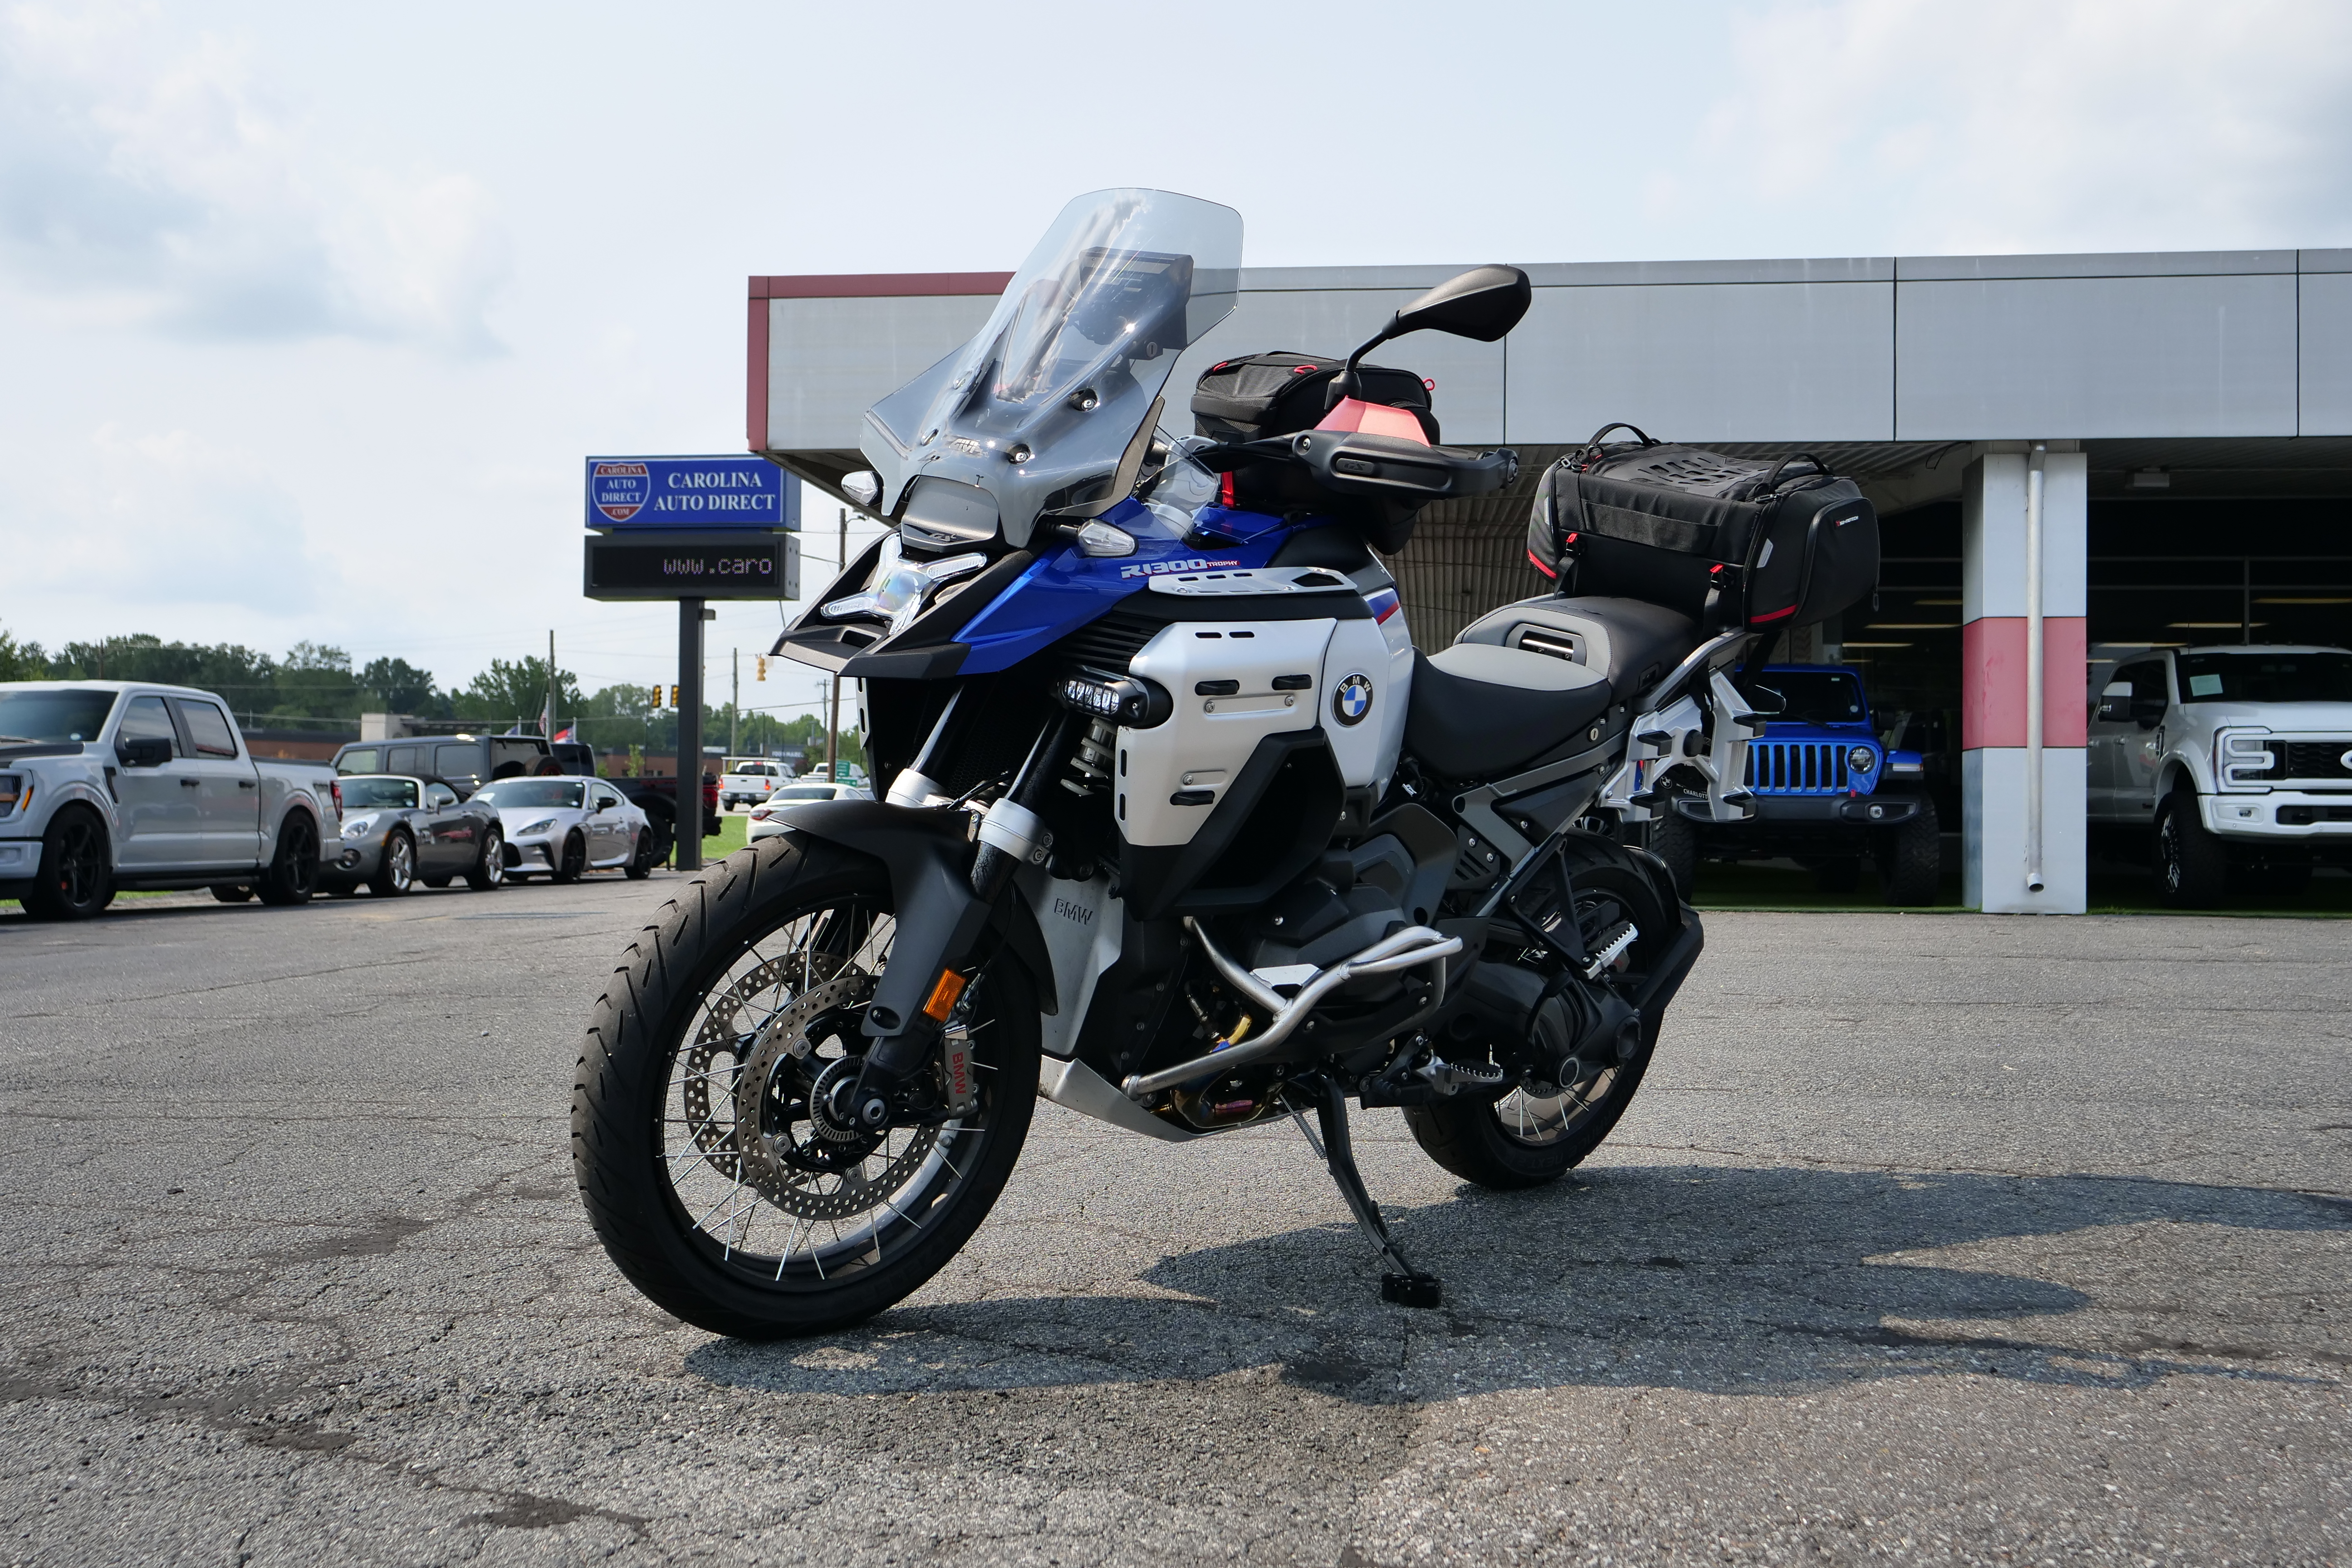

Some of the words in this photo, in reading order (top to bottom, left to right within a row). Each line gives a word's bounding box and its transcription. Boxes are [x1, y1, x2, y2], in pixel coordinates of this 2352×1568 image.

[600, 466, 643, 475] CAROLINA
[607, 479, 636, 490] AUTO
[668, 472, 763, 489] CAROLINA
[602, 491, 641, 503] DIRECT
[654, 495, 704, 511] AUTO
[708, 494, 776, 511] DIRECT
[611, 507, 630, 516] .COM
[663, 558, 772, 575] www.caro
[1120, 559, 1208, 579] R1300
[1339, 676, 1372, 693] BMW
[1683, 789, 1708, 799] CHARLOTT
[1054, 898, 1093, 926] BMW
[952, 1052, 966, 1094] BMW
